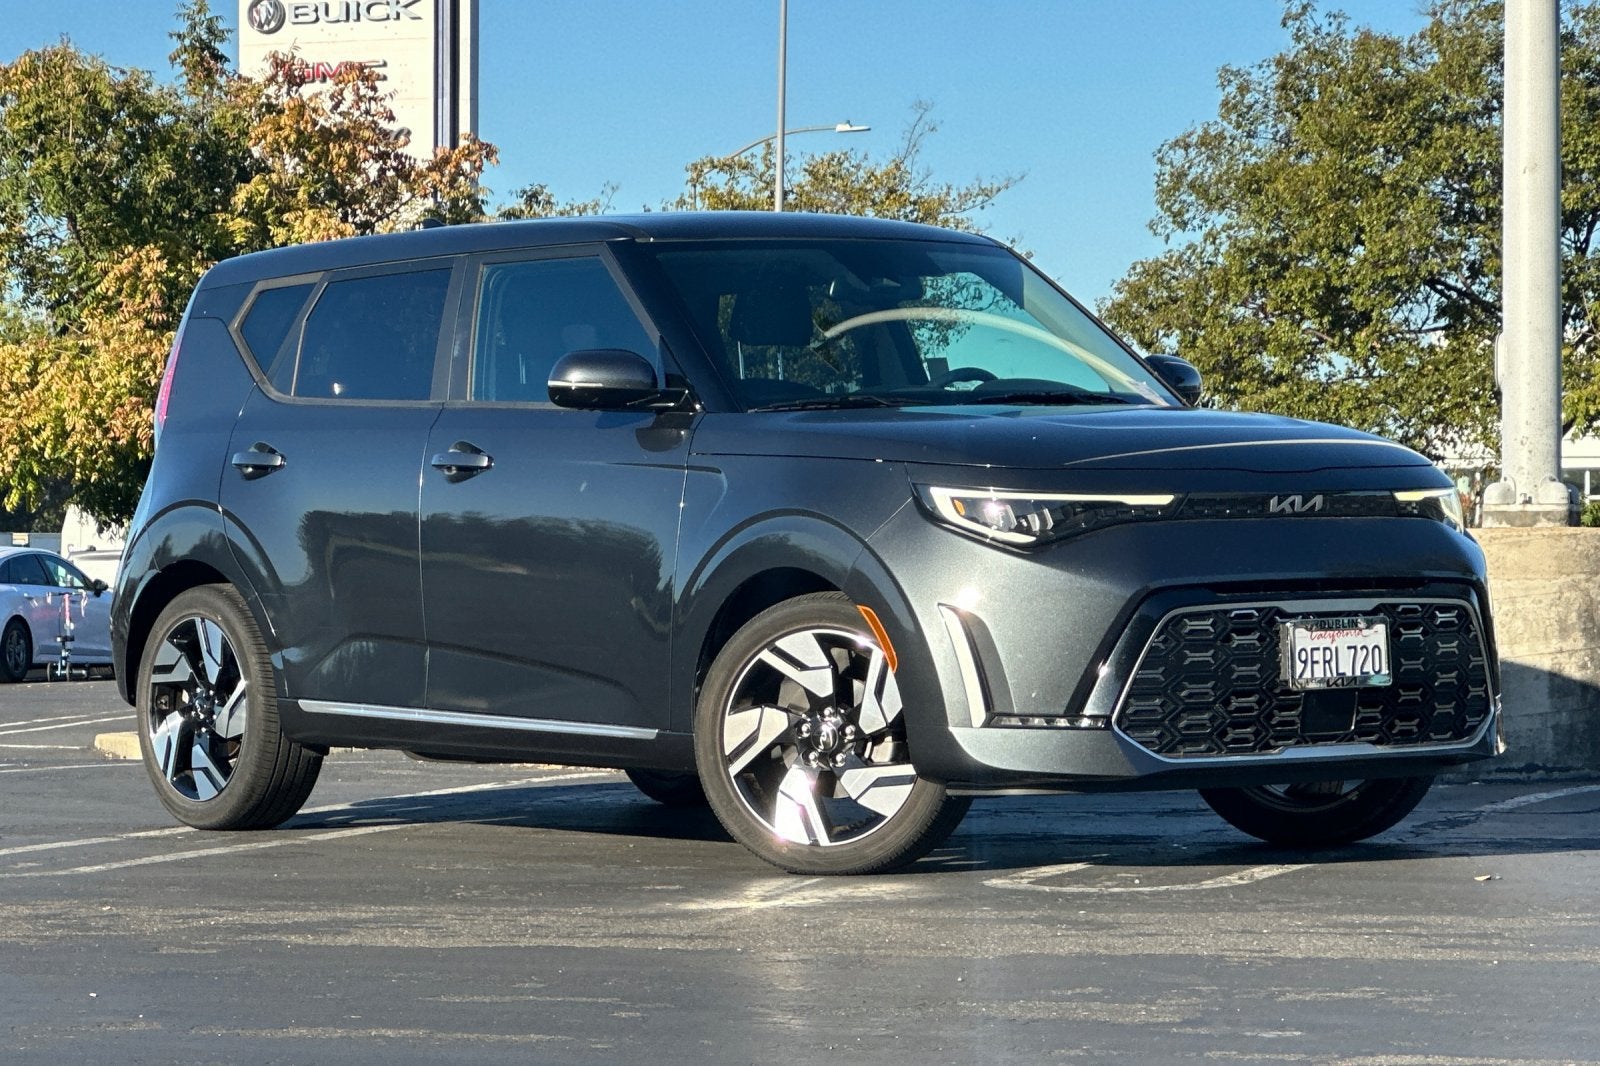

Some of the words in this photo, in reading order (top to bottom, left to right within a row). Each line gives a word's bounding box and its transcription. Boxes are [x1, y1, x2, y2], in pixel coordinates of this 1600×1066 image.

[288, 0, 423, 25] BUICK
[1269, 494, 1323, 513] KIA
[1320, 618, 1359, 629] DUBLIN
[1309, 629, 1365, 644] California
[1297, 644, 1382, 679] 9FRL720
[1326, 676, 1358, 687] KIA
